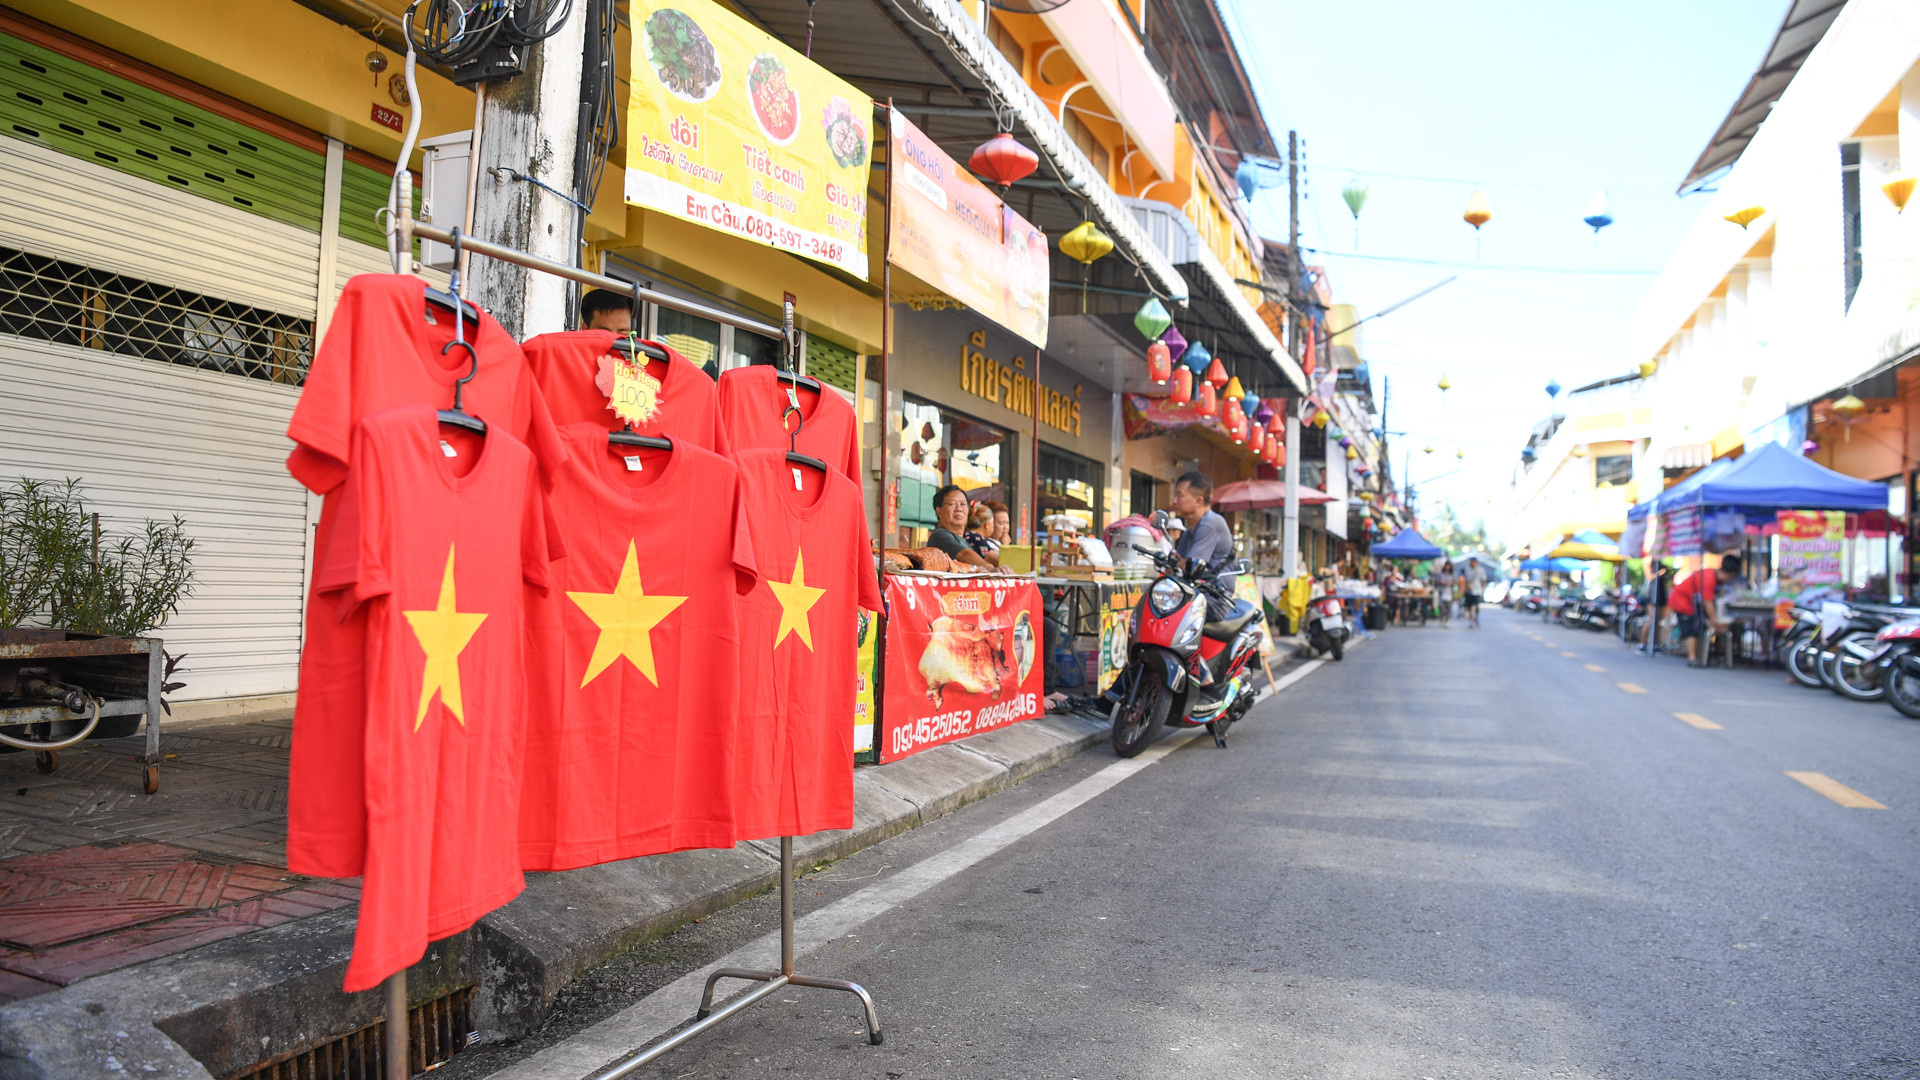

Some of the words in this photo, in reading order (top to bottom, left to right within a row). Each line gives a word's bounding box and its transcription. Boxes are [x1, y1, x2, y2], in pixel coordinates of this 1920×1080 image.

[377, 109, 399, 127] 22/7
[670, 114, 698, 149] dồi
[742, 143, 772, 176] Tiết
[774, 164, 805, 191] canh
[686, 194, 708, 220] Em
[825, 183, 848, 207] Giò
[955, 199, 972, 225] HEO
[614, 361, 634, 380] Hot
[638, 369, 660, 391] item
[620, 383, 647, 408] 100
